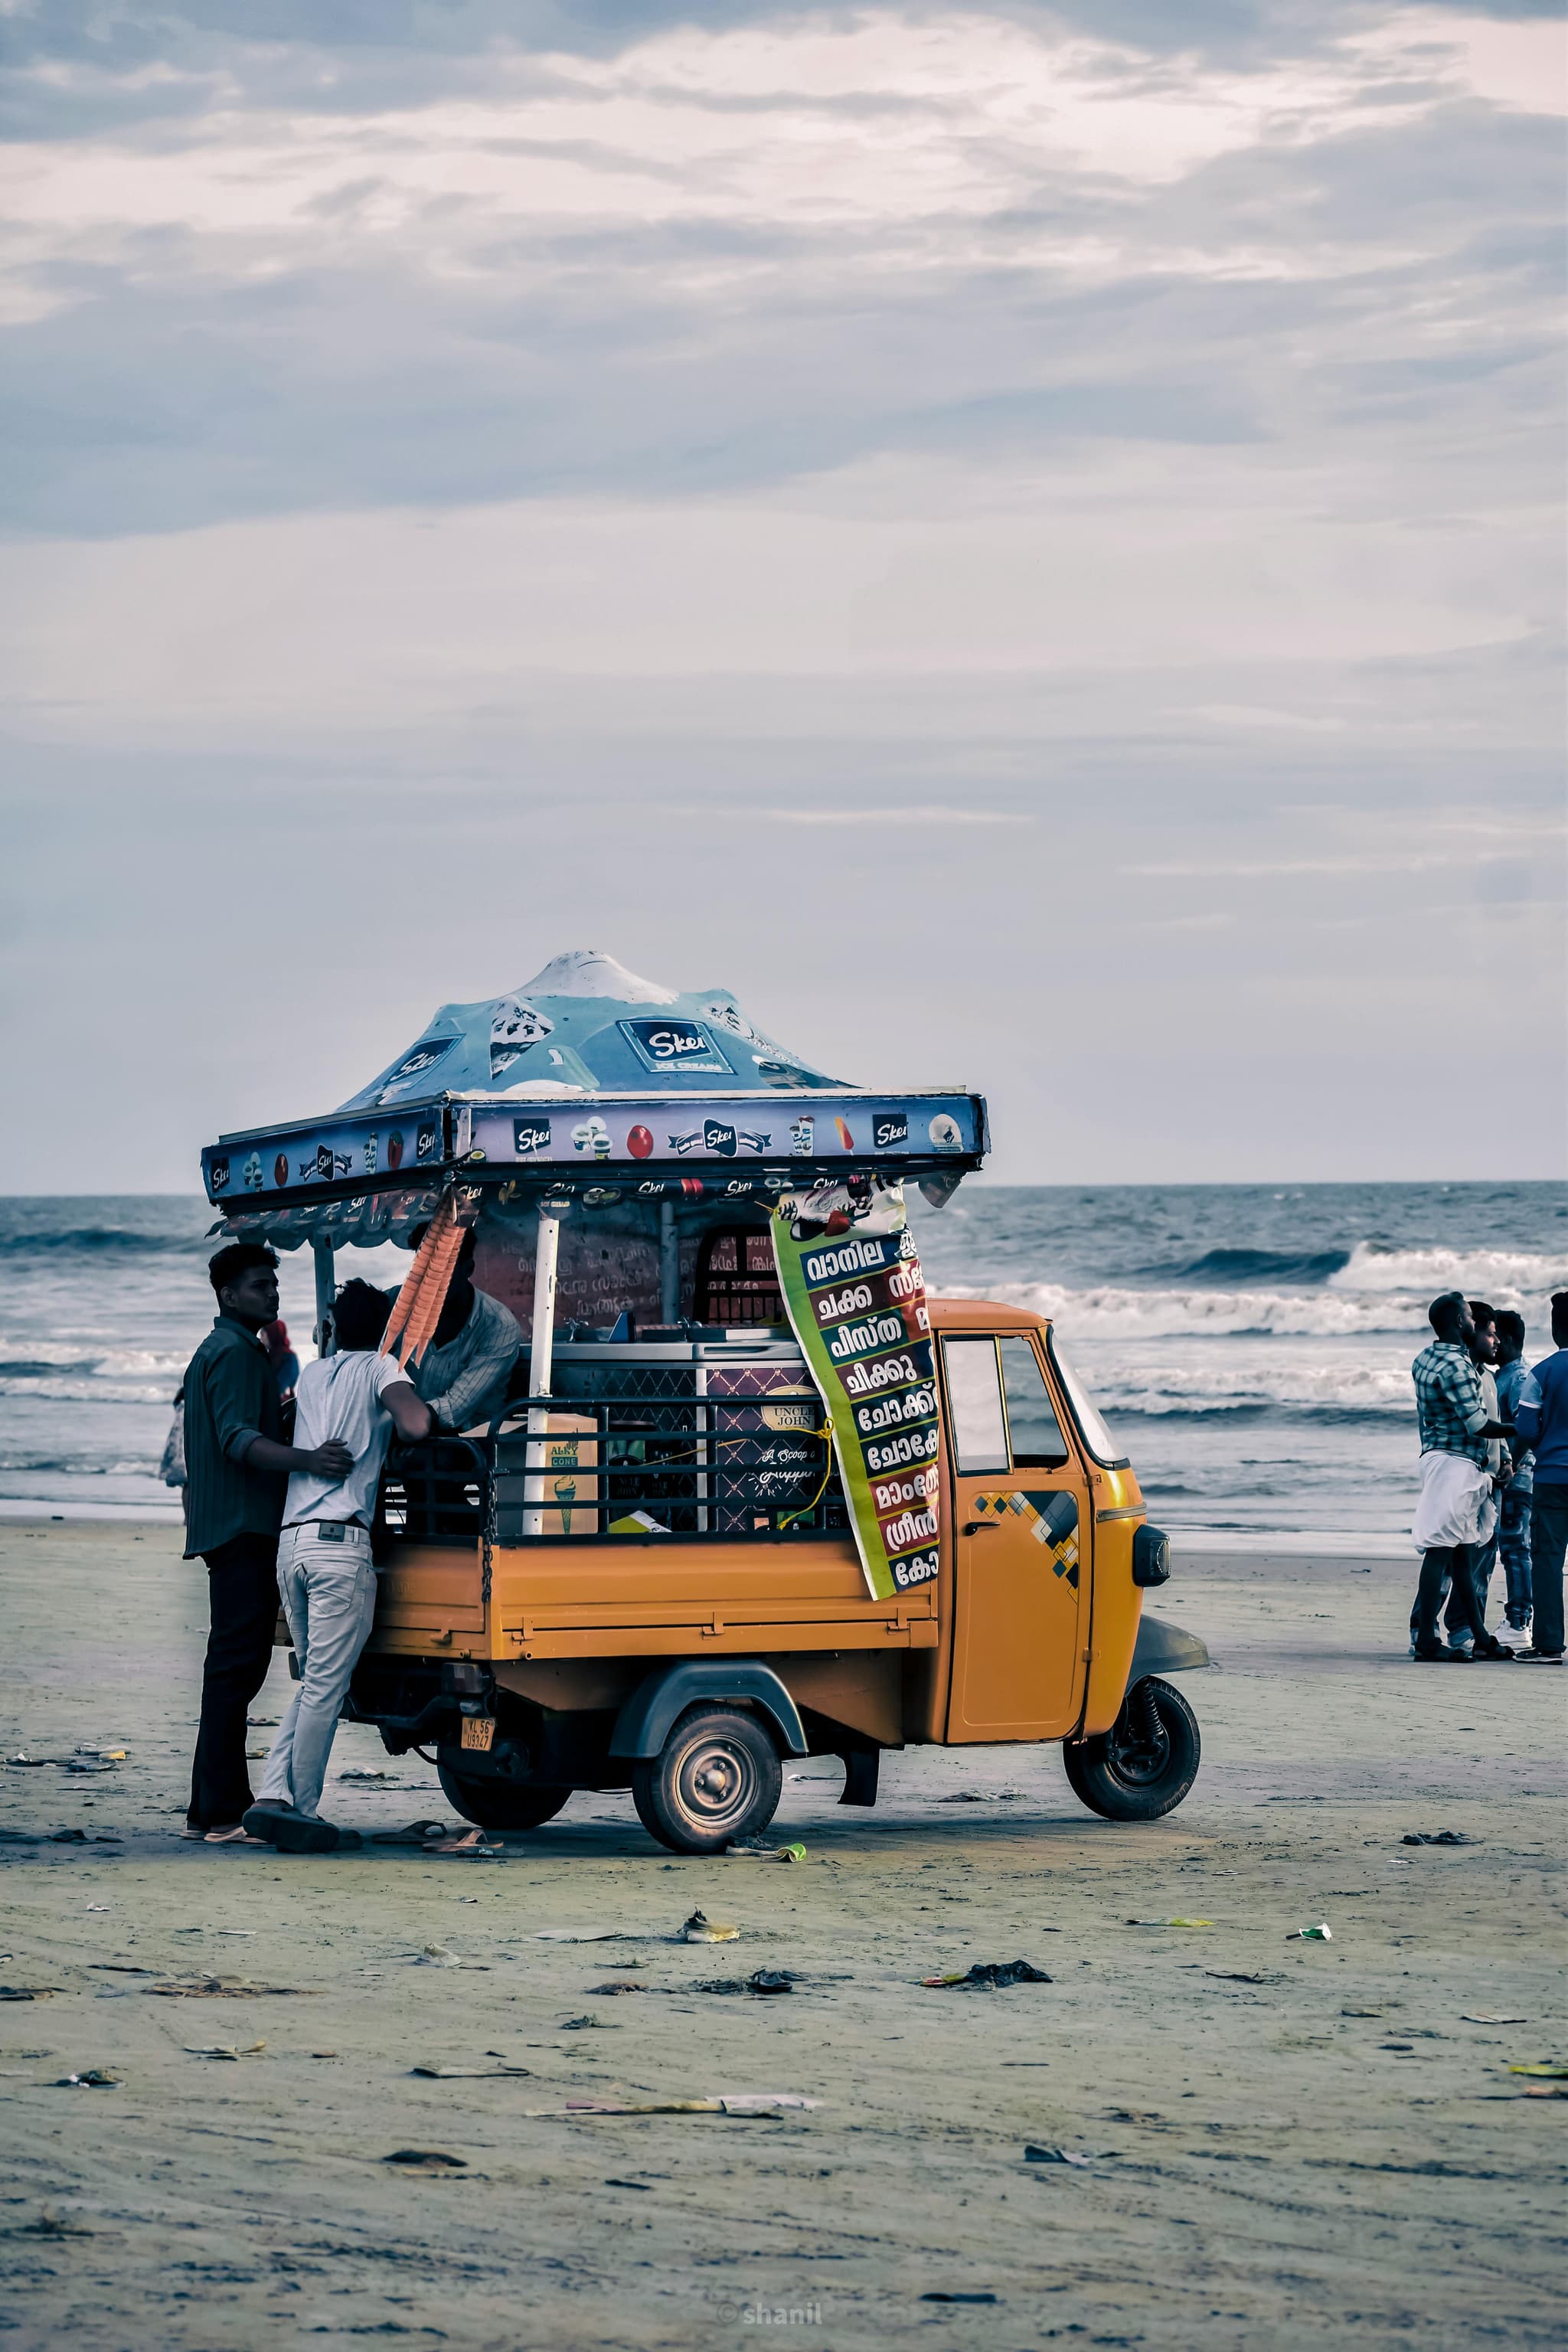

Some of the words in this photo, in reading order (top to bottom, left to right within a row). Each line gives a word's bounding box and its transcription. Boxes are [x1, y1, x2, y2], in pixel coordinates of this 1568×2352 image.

[807, 1240, 886, 1281] വാനില
[818, 1284, 873, 1321] ചക്ക
[831, 1316, 902, 1357] പിസ്ത
[846, 1354, 917, 1394] ചിക്കു
[774, 1407, 815, 1416] UNCLE
[778, 1416, 812, 1426] JOHN
[778, 1449, 808, 1462] Scoop
[469, 1720, 478, 1733] KL
[480, 1720, 490, 1734] 56
